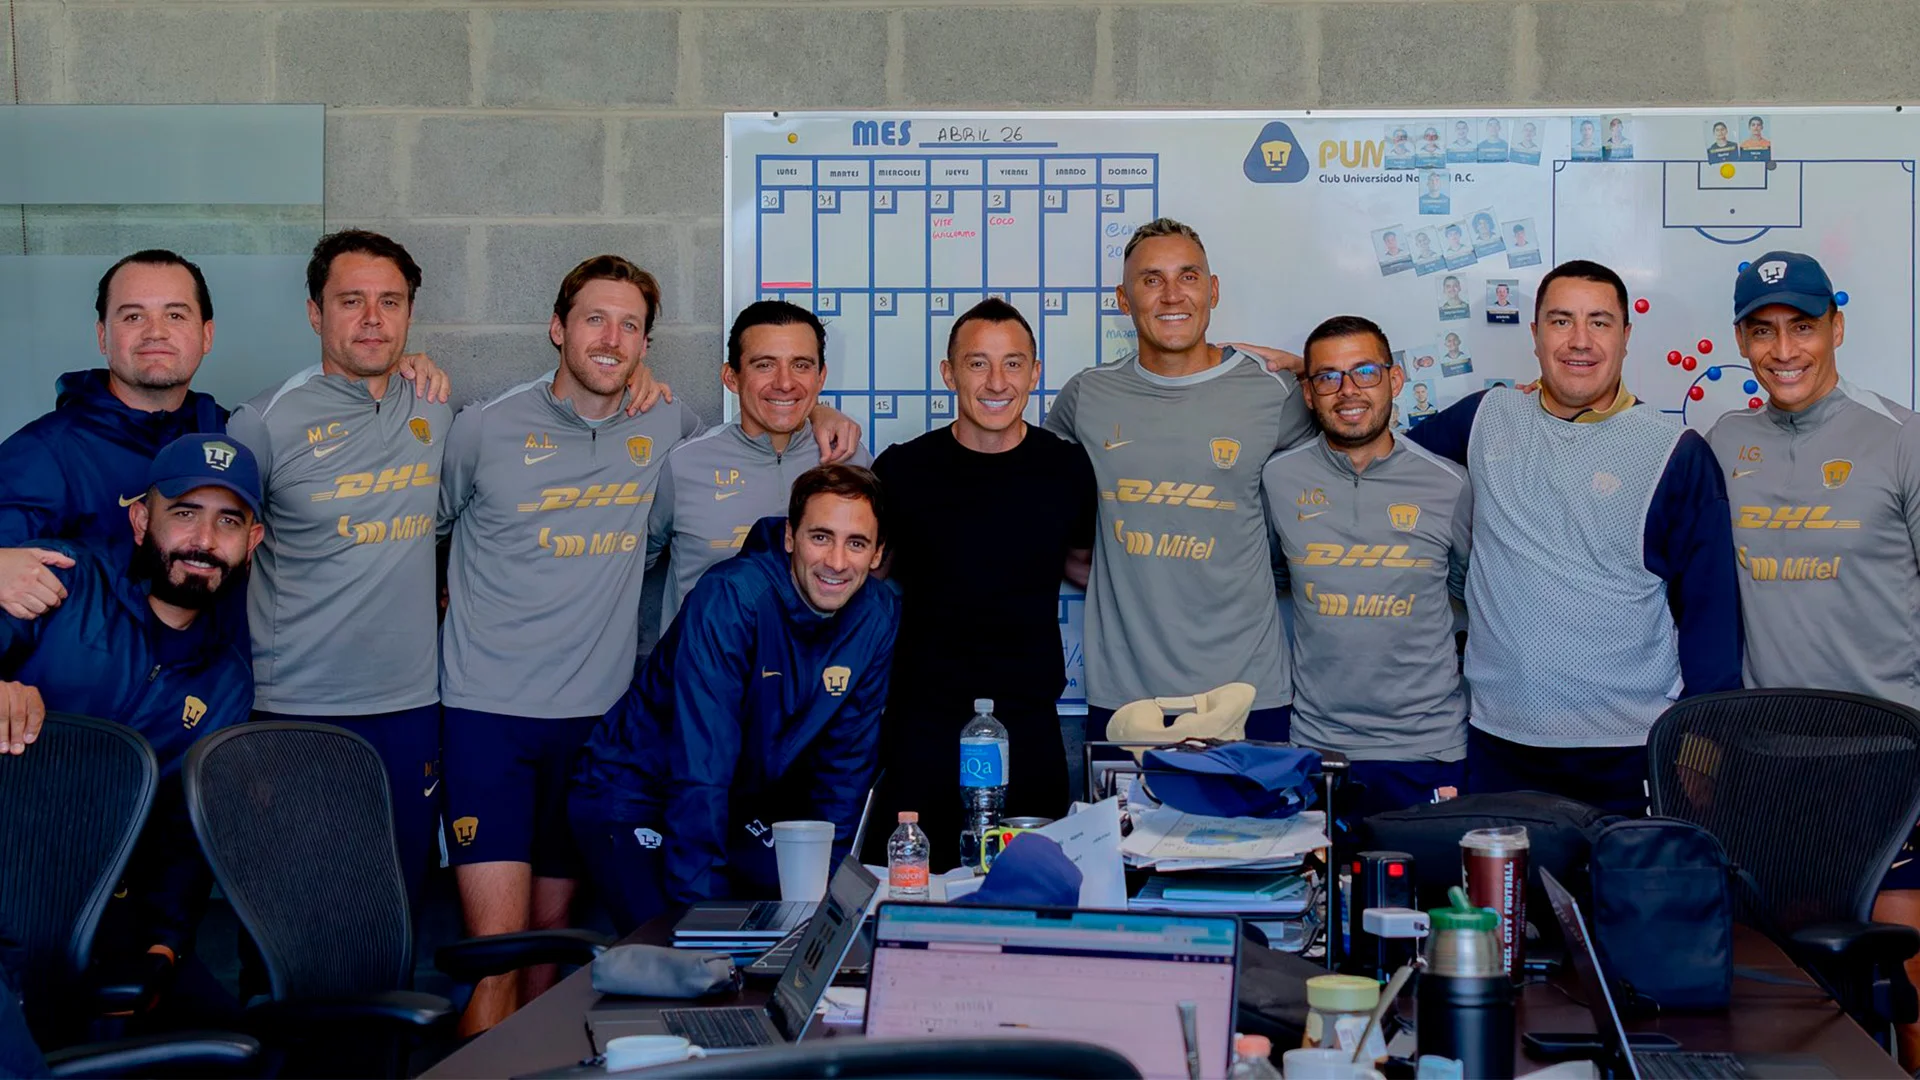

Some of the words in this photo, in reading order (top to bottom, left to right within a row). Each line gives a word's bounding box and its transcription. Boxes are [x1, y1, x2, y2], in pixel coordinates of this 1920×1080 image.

[852, 120, 911, 146] MES
[937, 126, 991, 142] ABRIL
[1000, 126, 1023, 142] 26
[776, 168, 797, 176] LUNES
[878, 169, 921, 177] MIERCOLES
[945, 168, 969, 176] JUEVES
[999, 168, 1028, 176] VIERNES
[1055, 168, 1086, 176] SABADO
[1108, 168, 1147, 176] DOMINGO
[1319, 173, 1340, 184] Club
[1343, 173, 1403, 183] Universidad
[1454, 173, 1475, 183] A.C.
[762, 195, 777, 207] 30
[818, 194, 833, 206] 31
[879, 195, 888, 206] 1
[934, 193, 942, 205] 2
[993, 194, 1002, 206] 3
[1047, 194, 1055, 205] 4
[1105, 193, 1115, 205] 5
[989, 216, 1015, 226] COCO
[822, 296, 830, 308] 7
[879, 296, 888, 307] 8
[935, 296, 943, 307] 9
[1045, 297, 1059, 308] 11
[1103, 298, 1116, 309] 12
[875, 400, 889, 410] 15
[931, 399, 945, 410] 16
[307, 422, 349, 445] M.C.
[524, 432, 558, 449] A.L.
[333, 462, 438, 499] DHL
[714, 469, 745, 485] L.P.
[538, 482, 645, 512] DHL
[1116, 478, 1220, 509] DHL
[1296, 488, 1330, 505] J.G.
[1738, 505, 1838, 529] DHL
[1155, 533, 1216, 560] Mifel
[1303, 542, 1418, 568] DHL
[1781, 556, 1841, 580] Mifel
[1351, 593, 1416, 617] Mifel
[1504, 860, 1514, 915] FOOTBALL
[1503, 917, 1513, 944] CITY
[1503, 946, 1513, 977] TEEL
